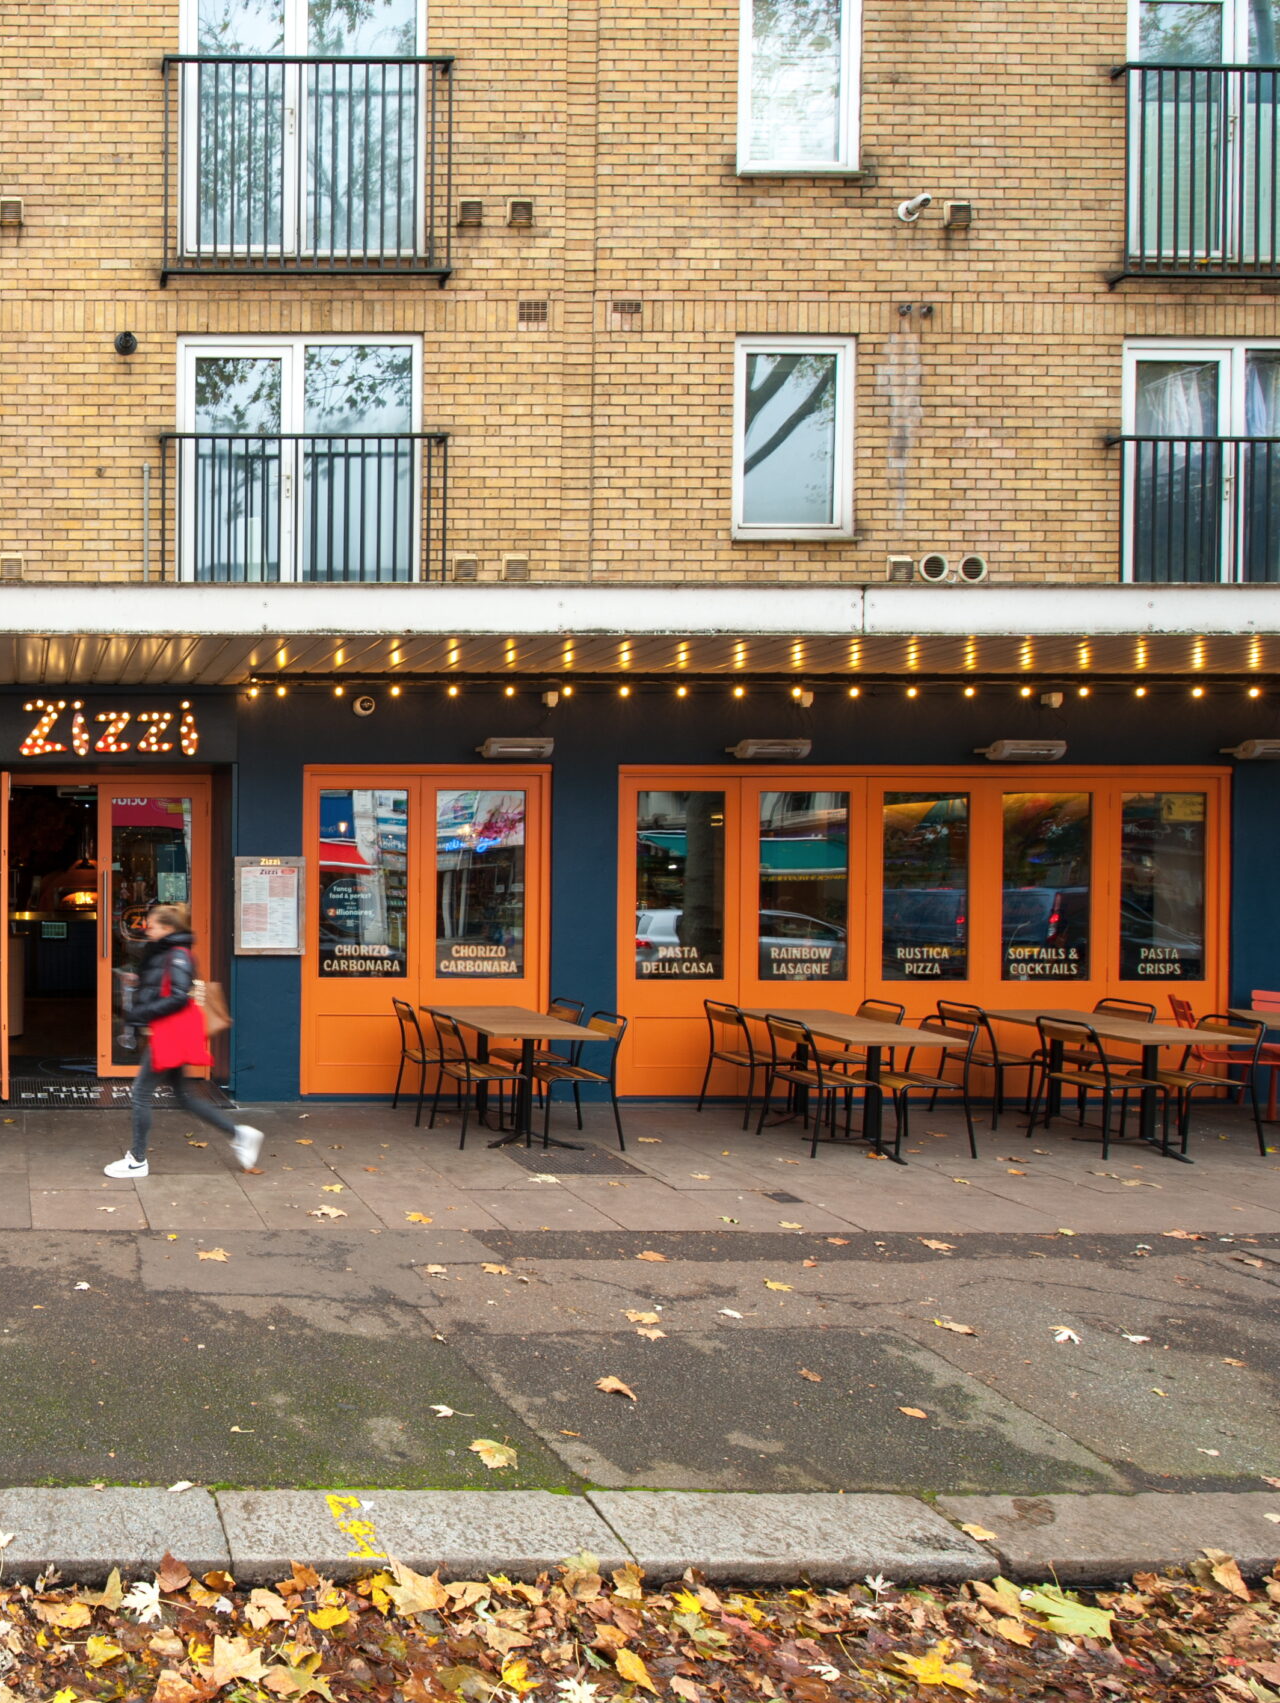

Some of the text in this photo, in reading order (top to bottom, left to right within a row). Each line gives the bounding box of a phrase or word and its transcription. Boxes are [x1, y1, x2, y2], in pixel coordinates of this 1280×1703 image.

[19, 699, 199, 756] Zizzi
[260, 857, 281, 866] Zizzi
[335, 944, 389, 957] CHORIZO
[451, 945, 506, 958] CHORIZO
[658, 947, 698, 959] PASTA
[770, 947, 832, 959] RAINBOW
[896, 947, 950, 959] RUSTICA
[1008, 947, 1078, 960] SOFTAILS &
[1140, 947, 1179, 960] PASTA
[323, 959, 401, 972] CARBONARA
[440, 960, 518, 973] CARBONARA
[642, 962, 714, 974] DELLA CASA
[772, 962, 829, 974] LASAGNE
[905, 963, 941, 975] PIZZA
[1009, 963, 1078, 975] COCKTAILS
[1137, 963, 1181, 975] CRISPS
